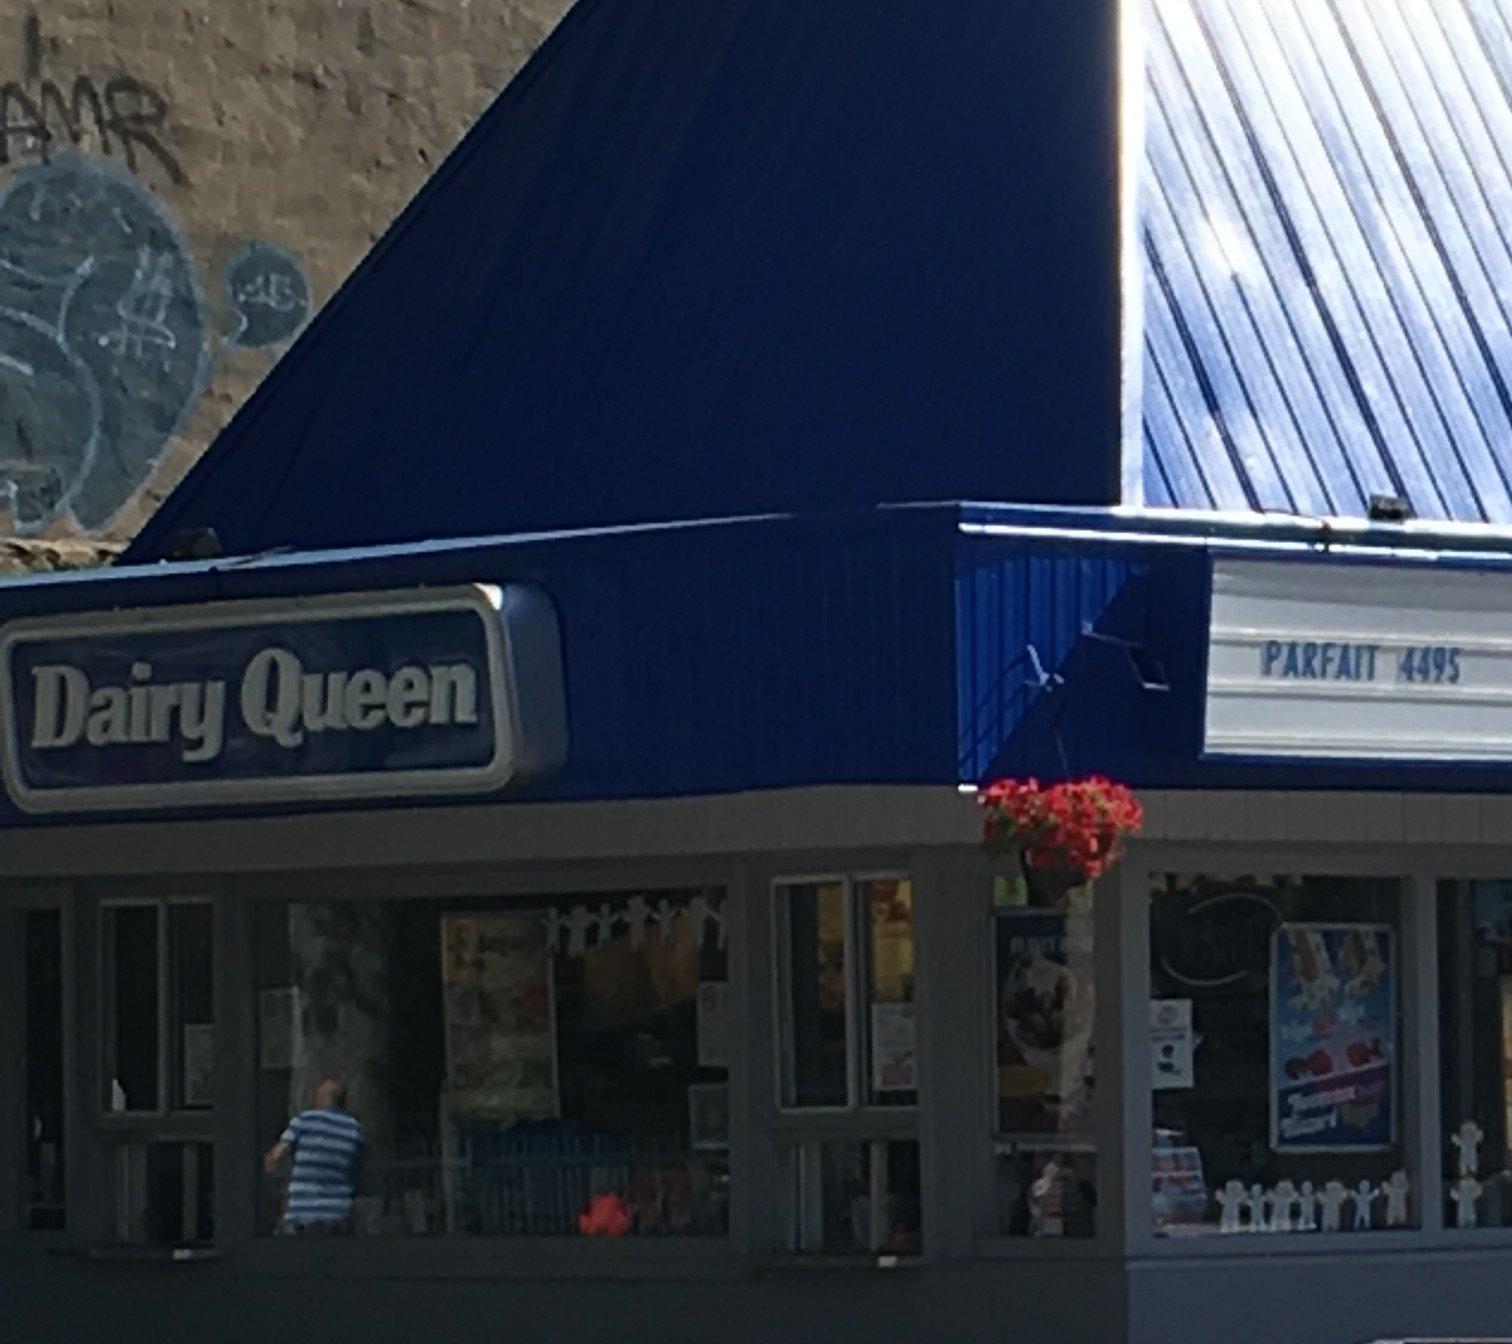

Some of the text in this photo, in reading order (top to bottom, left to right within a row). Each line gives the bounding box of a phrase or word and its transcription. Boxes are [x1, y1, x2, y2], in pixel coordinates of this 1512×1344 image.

[1261, 639, 1381, 682] PARFAIT
[30, 647, 478, 762] Dairy Queen
